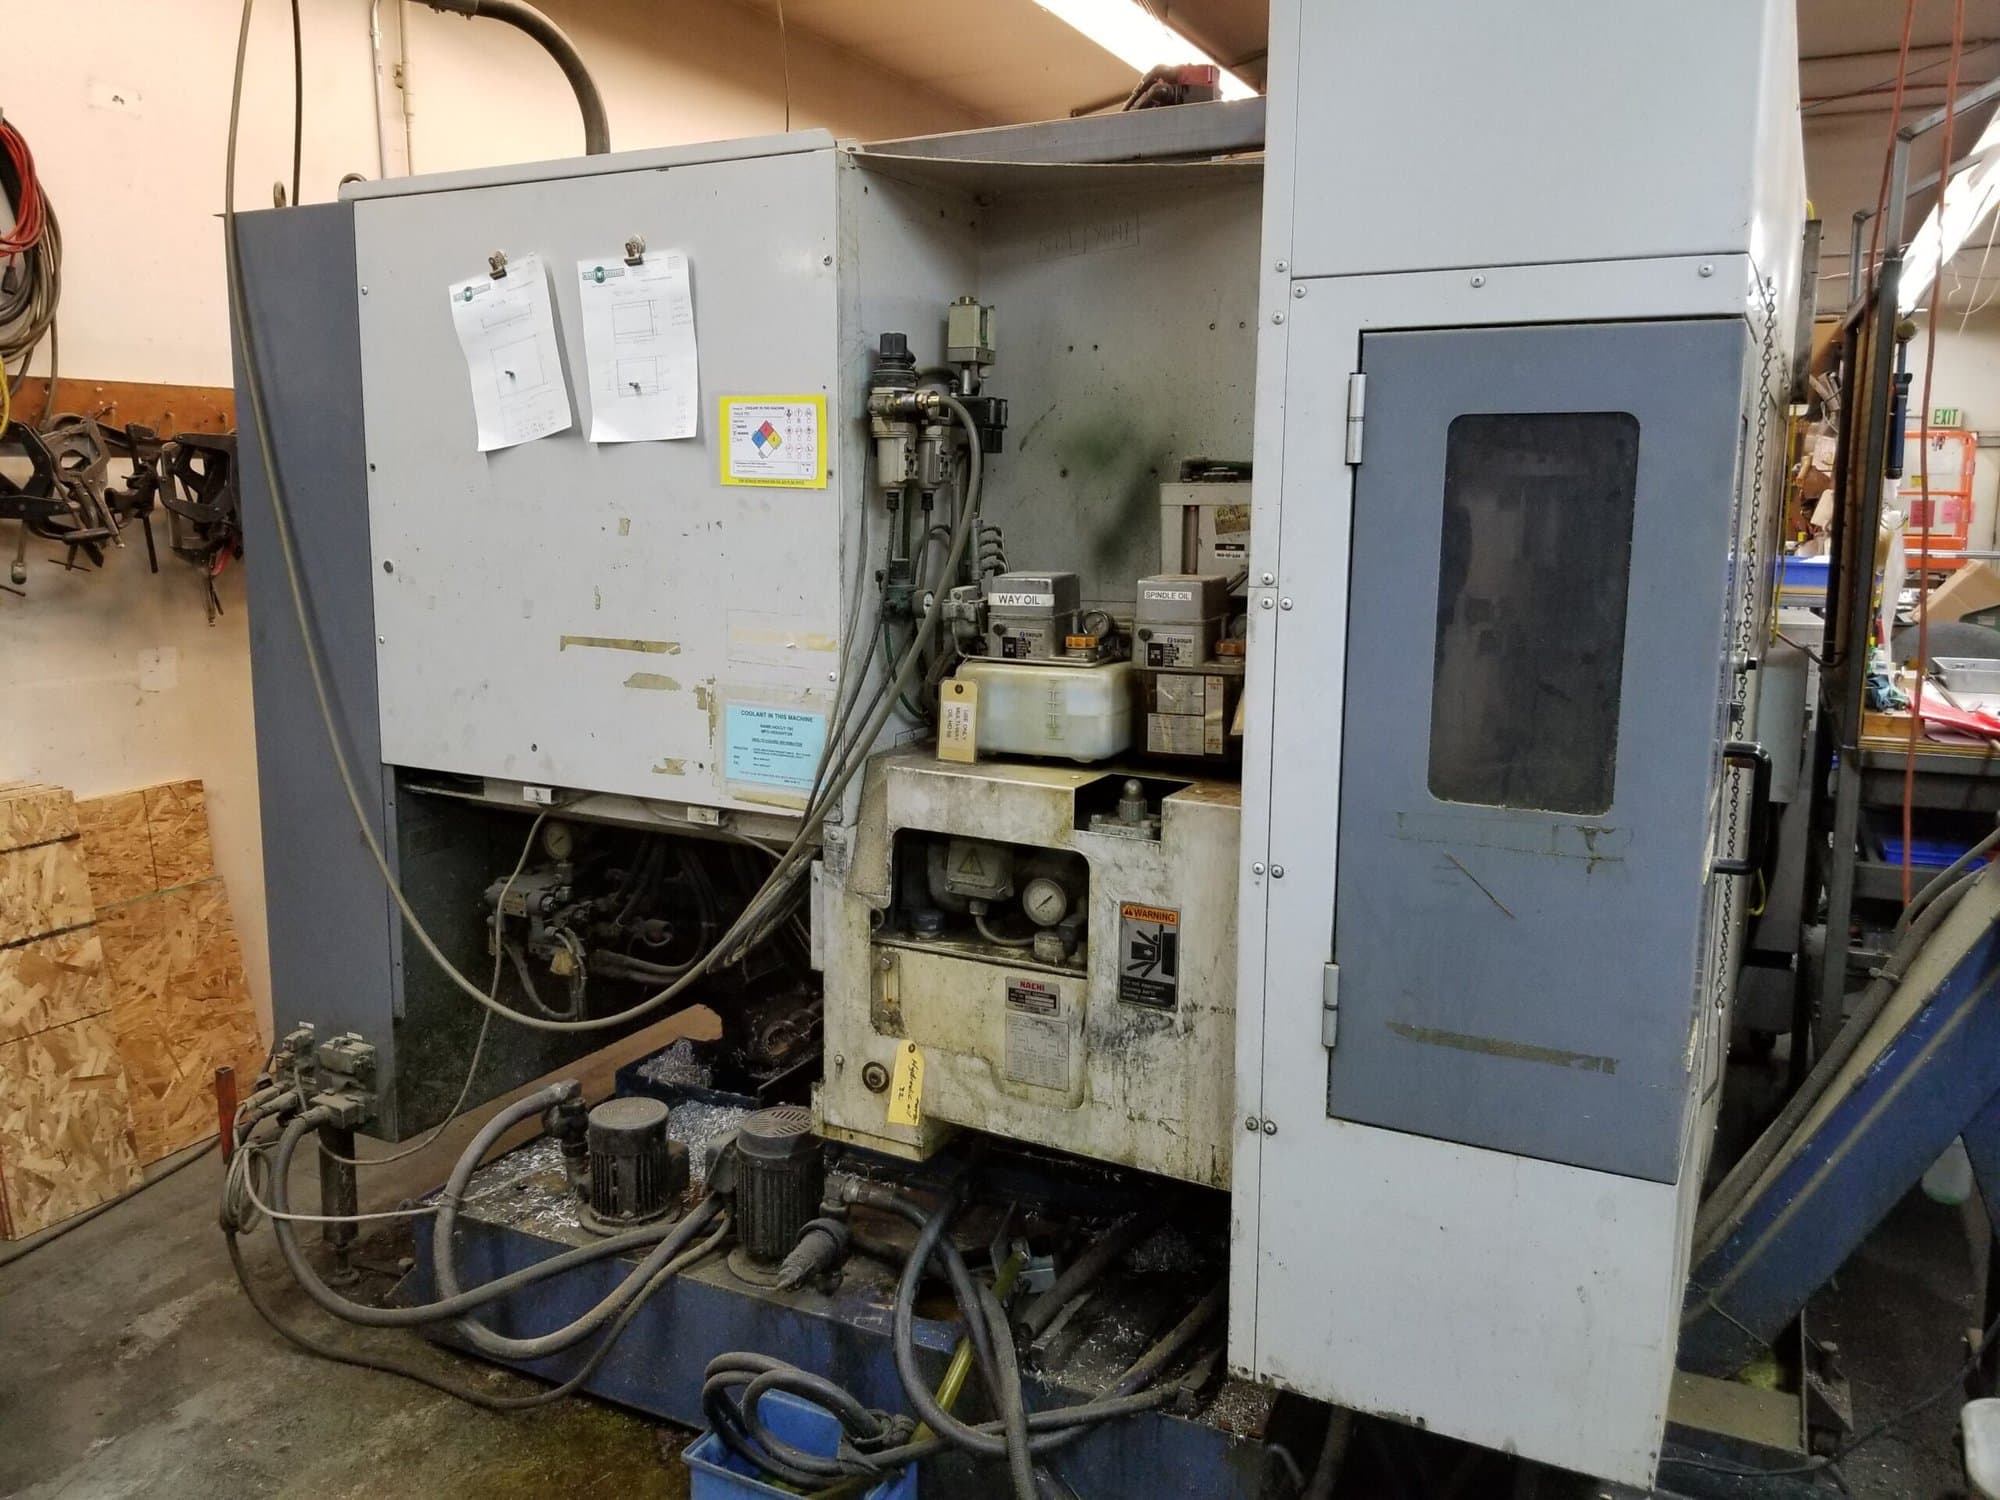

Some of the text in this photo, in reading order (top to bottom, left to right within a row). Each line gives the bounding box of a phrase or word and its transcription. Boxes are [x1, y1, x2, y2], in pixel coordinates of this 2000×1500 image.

[1933, 408, 1958, 425] EXIT
[998, 594, 1041, 605] WAY OIL
[1145, 591, 1190, 600] SPINDLE OIL
[741, 710, 767, 718] COOLANT
[775, 712, 787, 720] THIS
[788, 714, 813, 722] MACHINE
[1134, 908, 1175, 923] WARNING
[1020, 981, 1045, 992] NACHI
